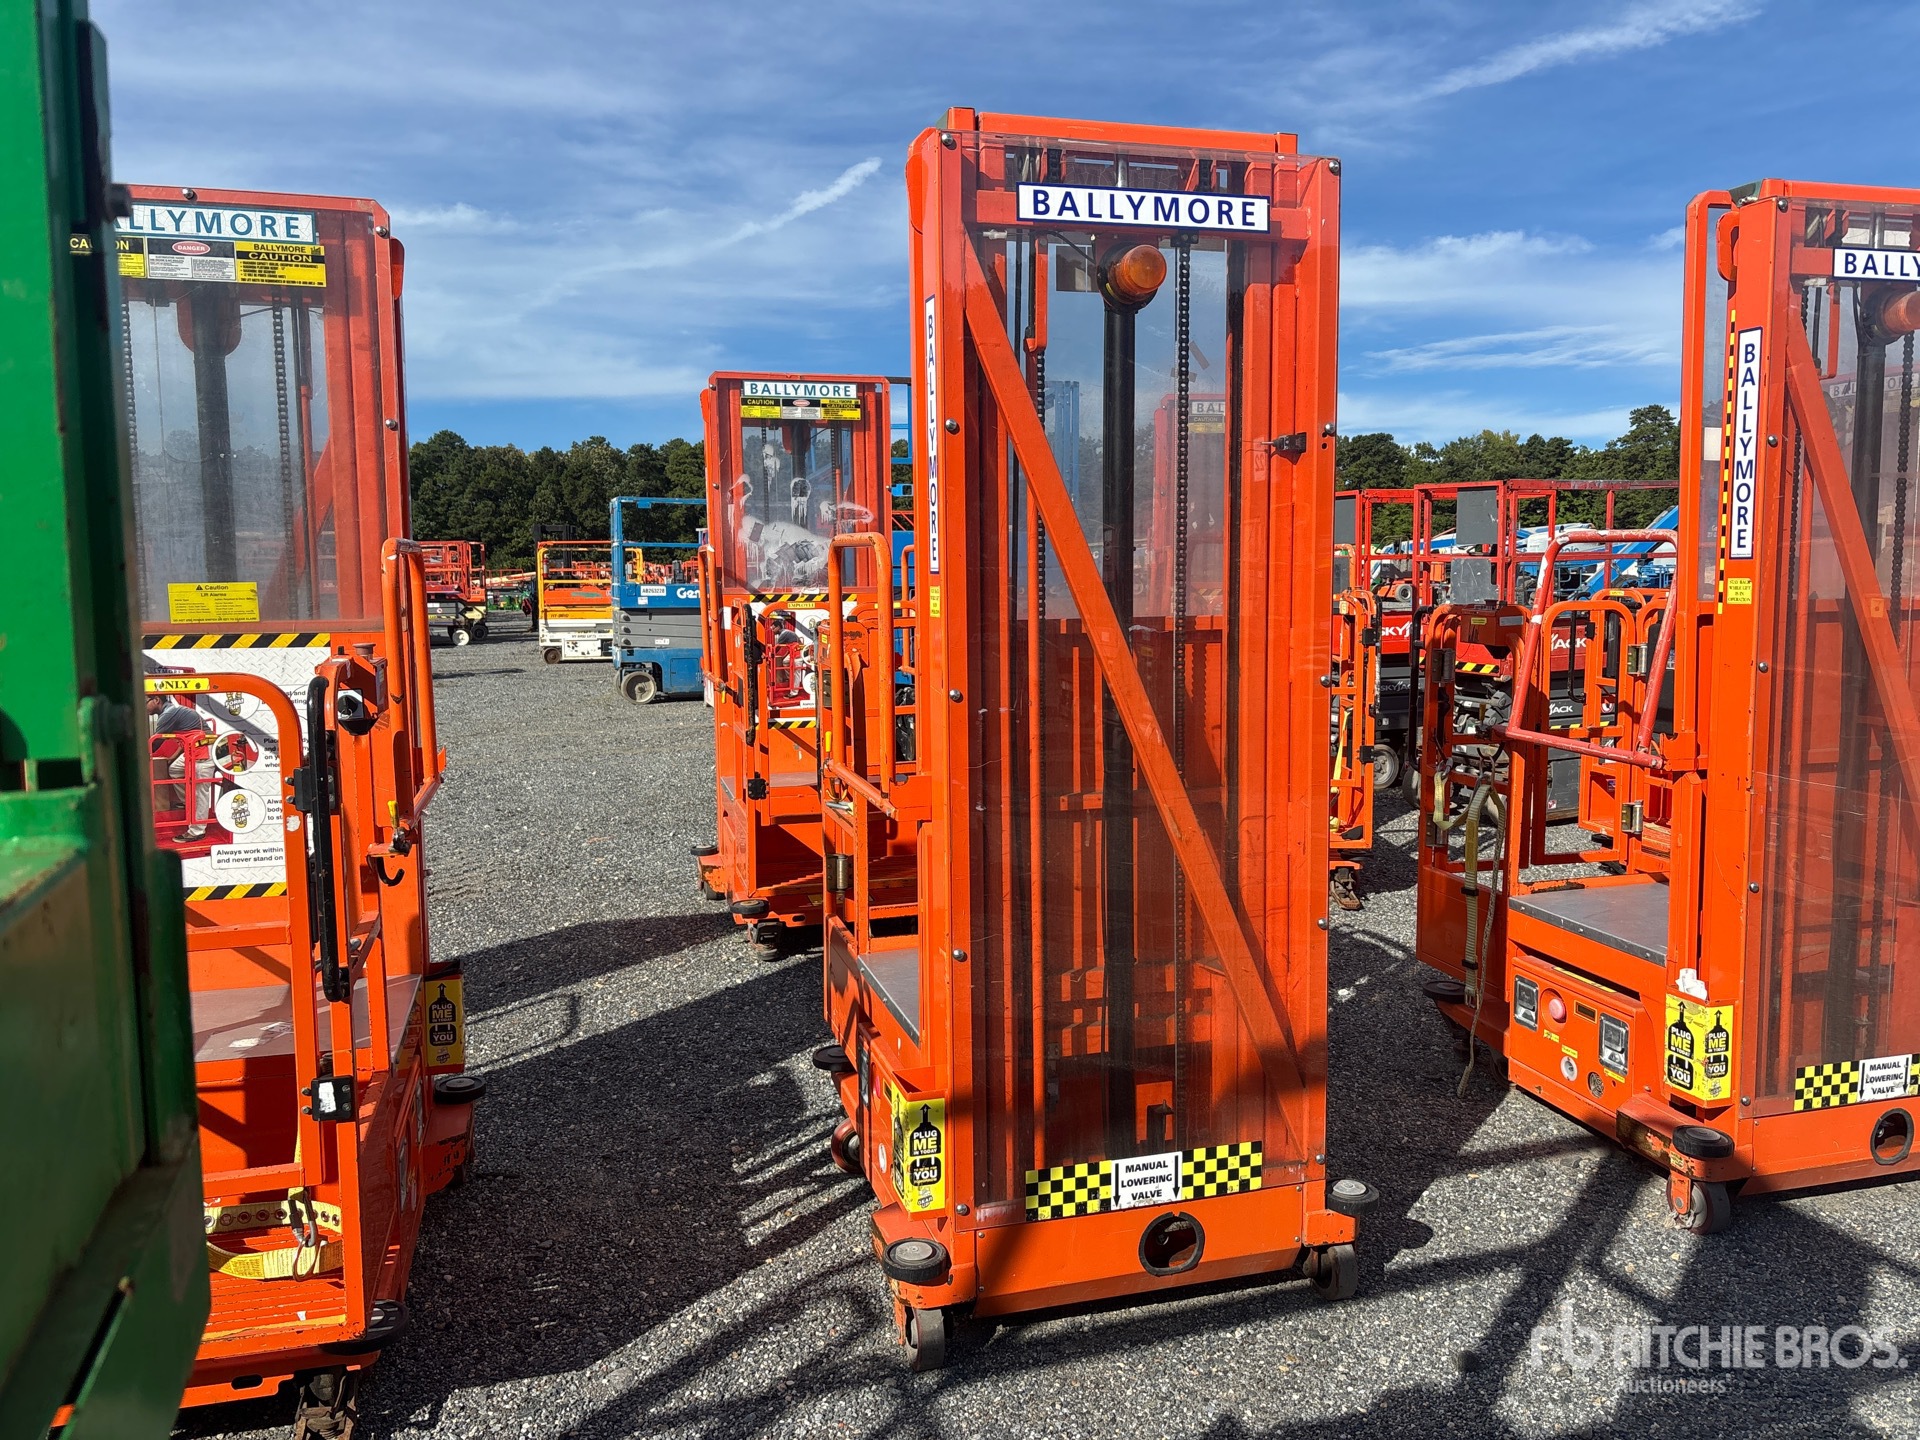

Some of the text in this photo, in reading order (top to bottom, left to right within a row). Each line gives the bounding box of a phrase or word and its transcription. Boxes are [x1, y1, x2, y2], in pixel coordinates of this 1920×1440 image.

[1032, 189, 1256, 227] BALLYMORE
[253, 243, 307, 253] BALLYMORE
[248, 252, 313, 263] CAUTION
[750, 383, 852, 397] BALLYMORE
[927, 314, 938, 561] BALLYMORE
[1735, 342, 1756, 549] BALLYMORE
[432, 1009, 453, 1018] ME
[432, 1033, 453, 1041] YOU
[1670, 1026, 1691, 1041] PLUG
[1708, 1031, 1727, 1039] PLUG
[1671, 1034, 1691, 1050] ME
[1708, 1037, 1727, 1049] ME
[1708, 1064, 1726, 1073] YOU
[1869, 1061, 1902, 1072] MANUAL
[1670, 1067, 1691, 1084] YOU
[1865, 1072, 1904, 1084] LOWERING
[1871, 1085, 1895, 1095] VALVE
[913, 1130, 938, 1139] PLUG
[913, 1137, 938, 1151] ME
[1125, 1160, 1168, 1174] MANUAL
[913, 1169, 938, 1180] YOU
[1121, 1173, 1173, 1188] LOWERING
[1131, 1188, 1163, 1201] VALVE
